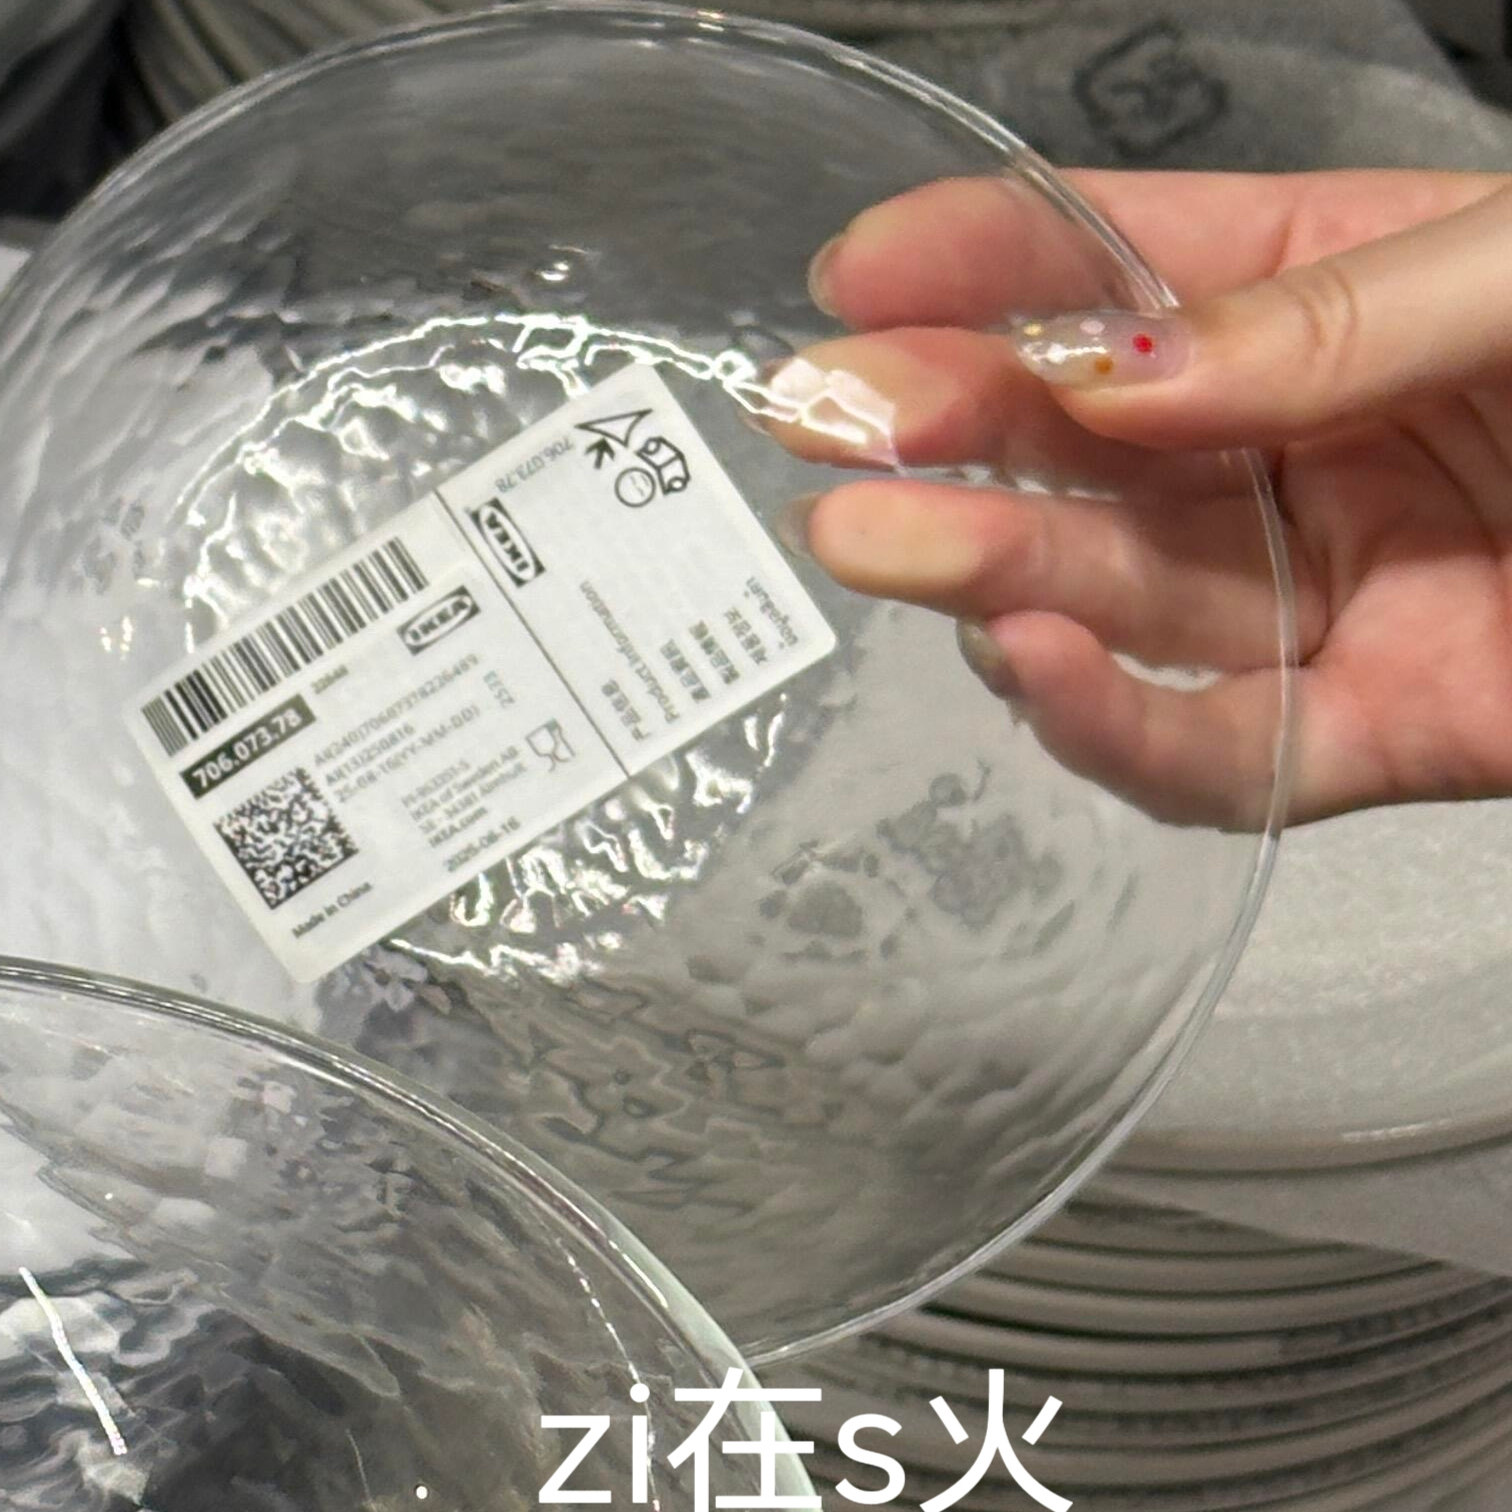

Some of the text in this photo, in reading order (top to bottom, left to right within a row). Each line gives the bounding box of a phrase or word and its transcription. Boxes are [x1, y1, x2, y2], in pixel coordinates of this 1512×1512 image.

[495, 435, 574, 493] 706.073.78
[601, 677, 651, 742] 产品信息
[632, 663, 680, 723] Product
[191, 706, 302, 789] 706.073.78
[450, 754, 504, 795] Sweden
[290, 878, 373, 939] Made in China
